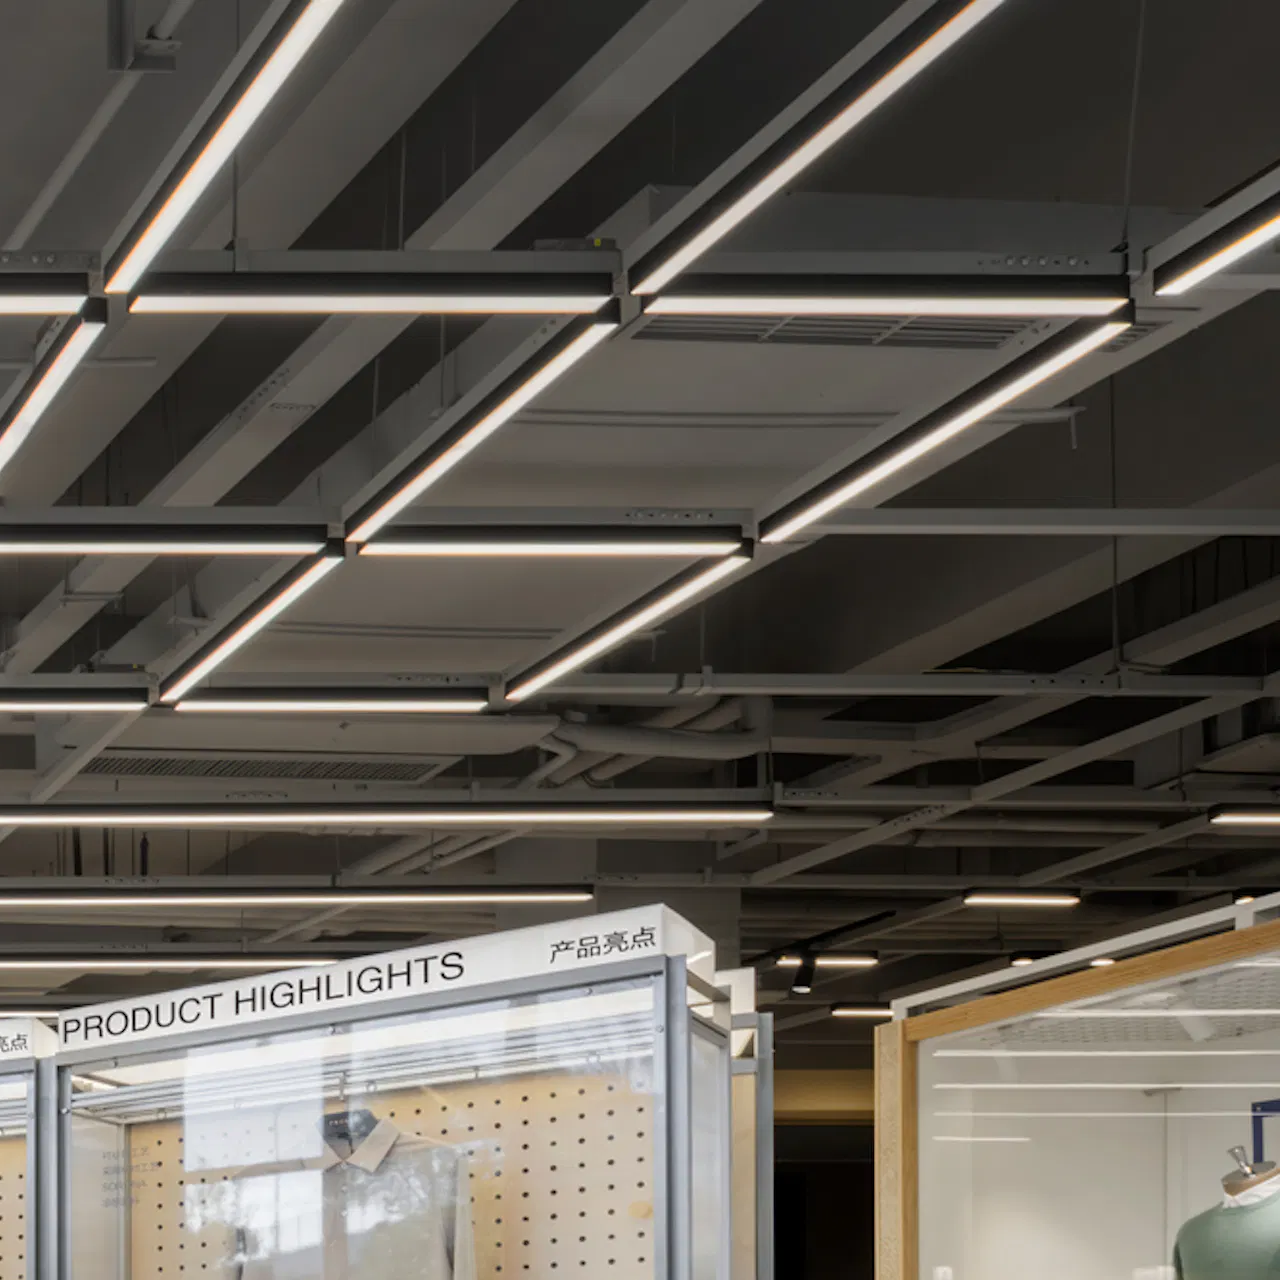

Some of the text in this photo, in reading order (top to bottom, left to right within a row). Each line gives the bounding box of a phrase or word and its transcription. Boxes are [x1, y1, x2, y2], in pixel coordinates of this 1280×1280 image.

[548, 926, 658, 965] 产品亮点
[62, 950, 466, 1044] PRODUCT HIGHLIGHTS
